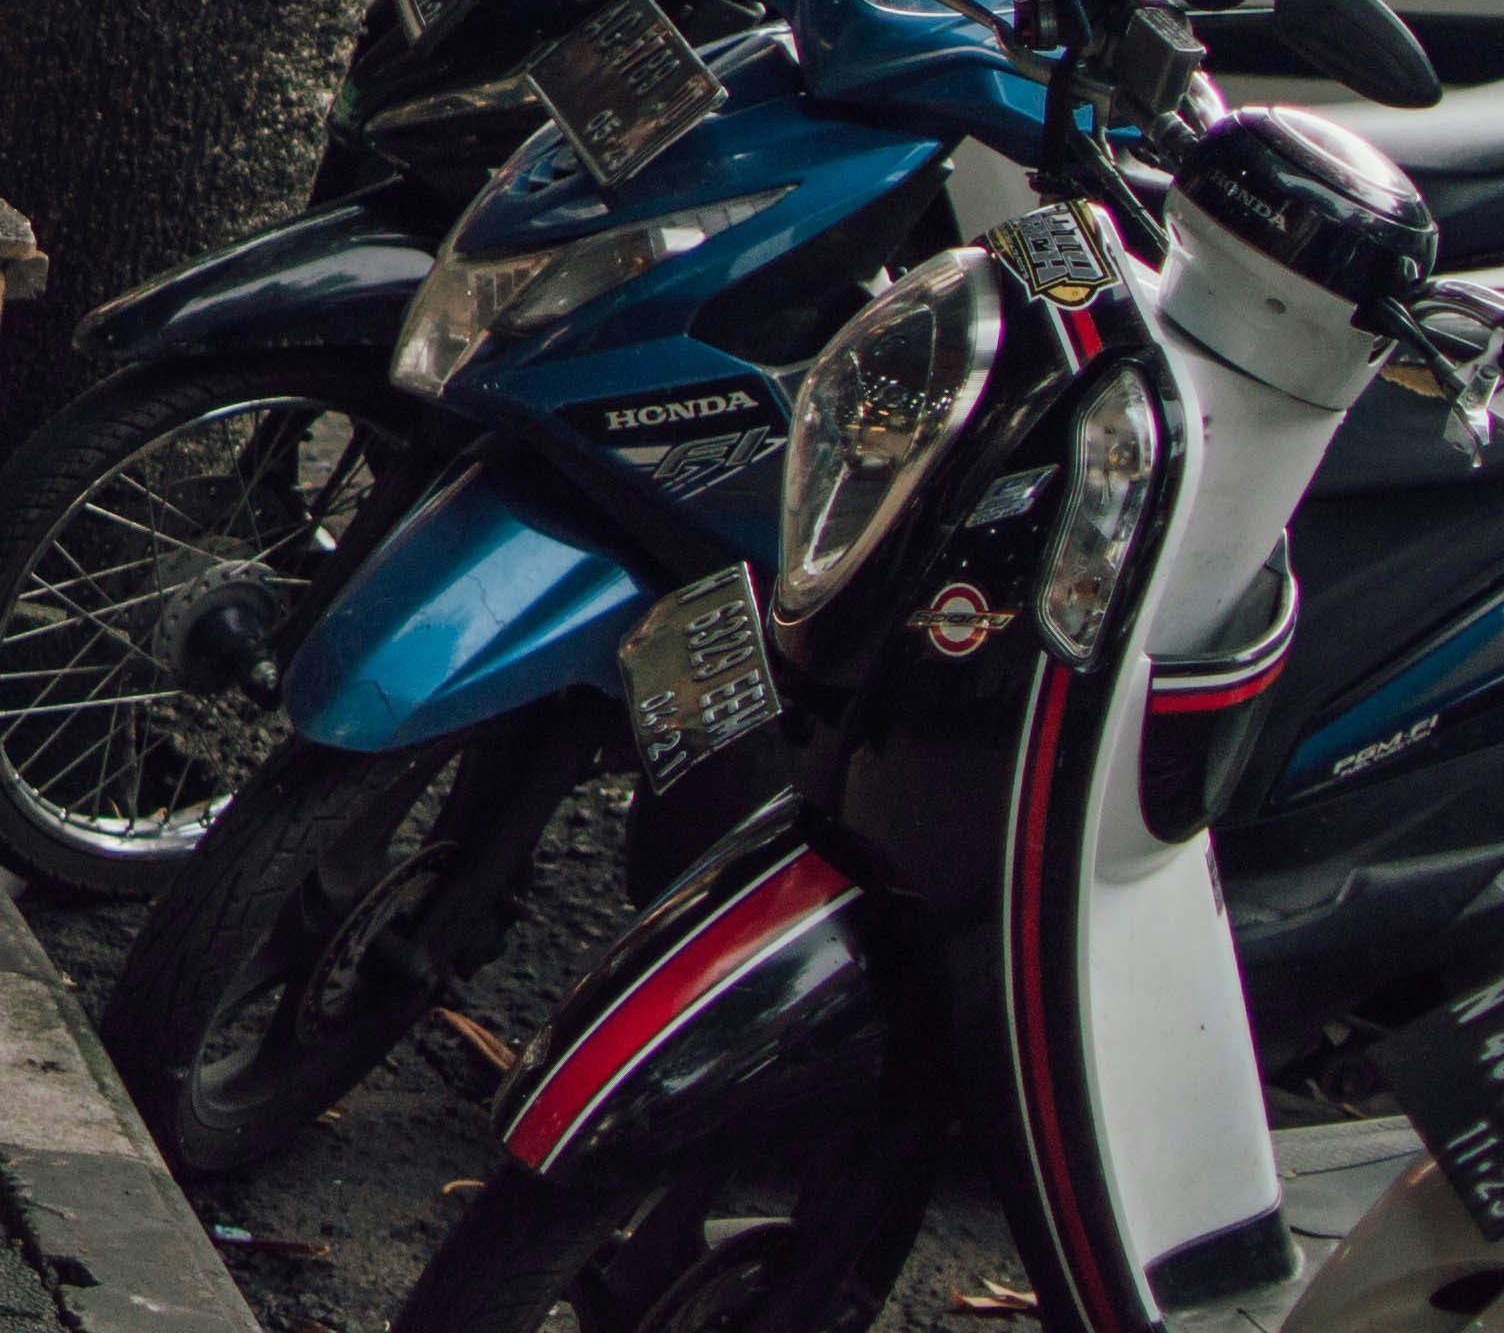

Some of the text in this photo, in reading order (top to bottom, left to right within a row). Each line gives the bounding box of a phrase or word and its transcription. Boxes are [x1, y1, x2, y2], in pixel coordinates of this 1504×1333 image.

[1210, 167, 1290, 232] HONDA
[604, 389, 760, 432] HONDA
[683, 597, 757, 683] 6329
